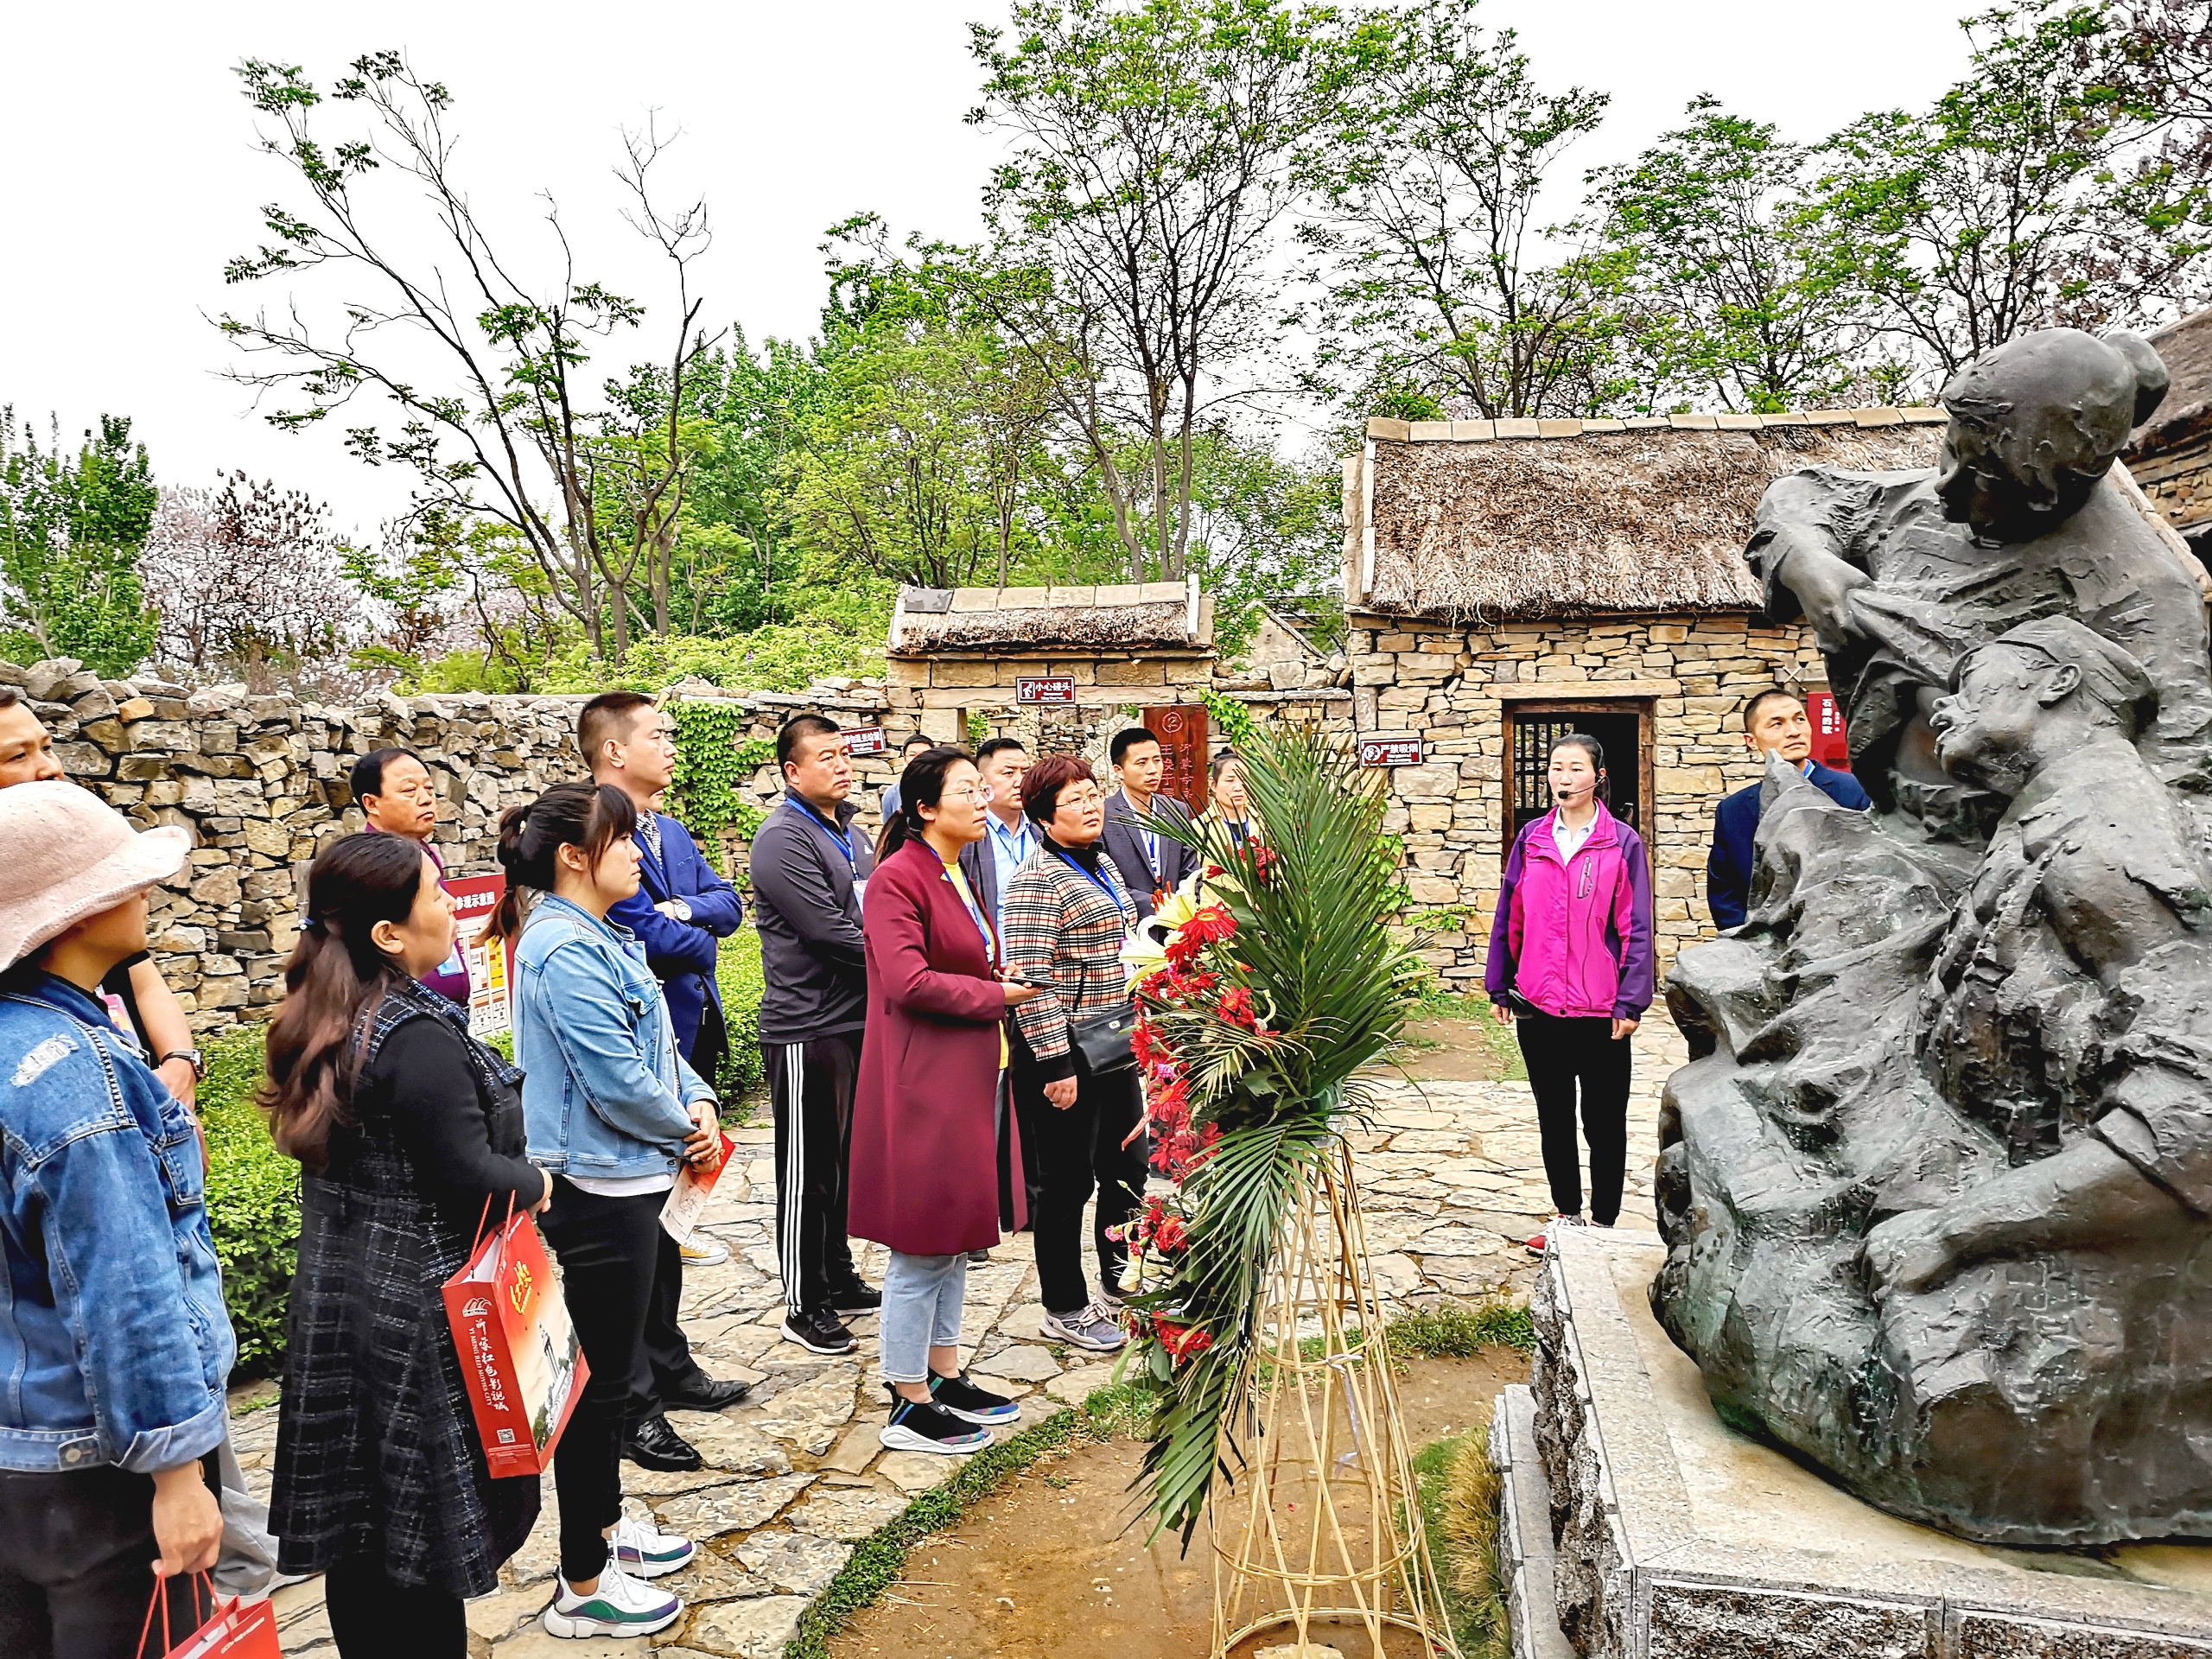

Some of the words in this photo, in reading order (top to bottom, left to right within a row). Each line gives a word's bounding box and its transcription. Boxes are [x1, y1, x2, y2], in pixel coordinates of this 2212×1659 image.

[1035, 682, 1071, 691] 小心碰头
[1380, 743, 1419, 754] 严禁吸烟
[454, 891, 495, 911] 参观示意图
[474, 1318, 510, 1412] 沂蒙红色影视城
